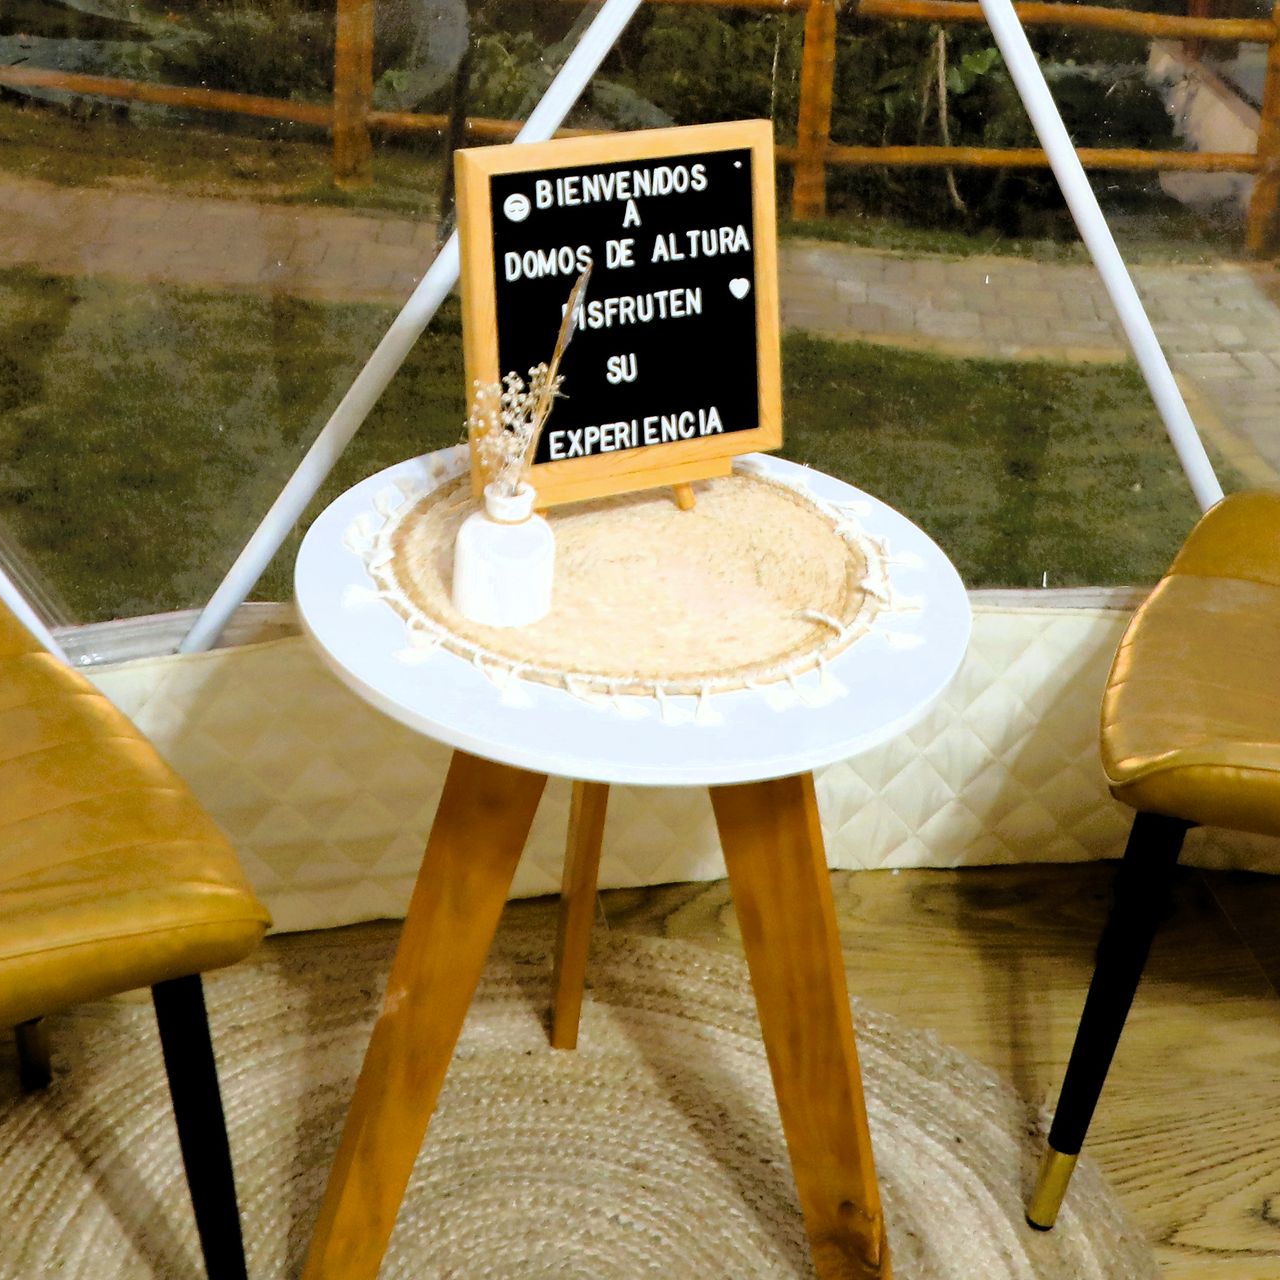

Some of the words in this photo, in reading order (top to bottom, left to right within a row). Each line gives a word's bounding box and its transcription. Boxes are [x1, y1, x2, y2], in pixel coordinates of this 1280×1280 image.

[535, 164, 707, 210] BIENVENIDOS
[622, 199, 642, 228] A
[504, 245, 593, 281] DOMOS
[606, 238, 635, 269] DE
[651, 224, 750, 263] ALTURA
[606, 353, 638, 384] SU
[549, 406, 723, 460] EXPERIENCIA
